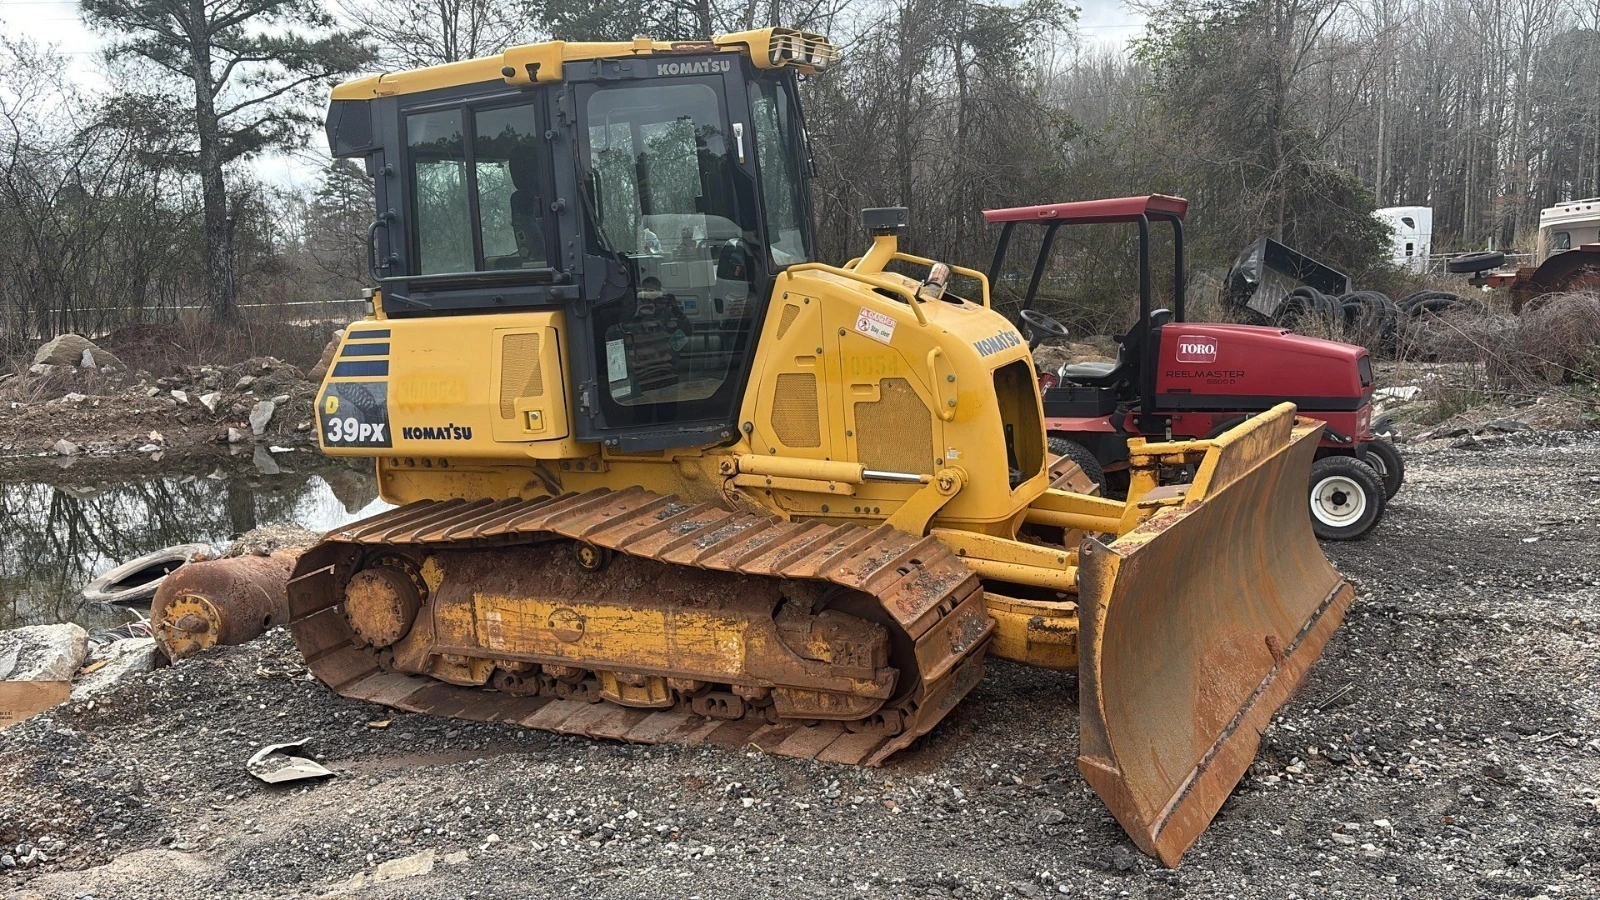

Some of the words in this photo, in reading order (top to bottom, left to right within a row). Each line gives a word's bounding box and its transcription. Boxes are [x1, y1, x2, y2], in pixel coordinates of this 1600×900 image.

[657, 58, 731, 75] KOMATSU
[870, 325, 879, 335] Stay
[880, 330, 891, 338] clear
[973, 329, 1021, 357] KOMATSU
[1179, 343, 1216, 355] TORO
[1166, 370, 1245, 378] REELMASTER
[325, 395, 339, 414] D
[327, 417, 385, 442] 39PX
[402, 423, 472, 441] KOMATSU
